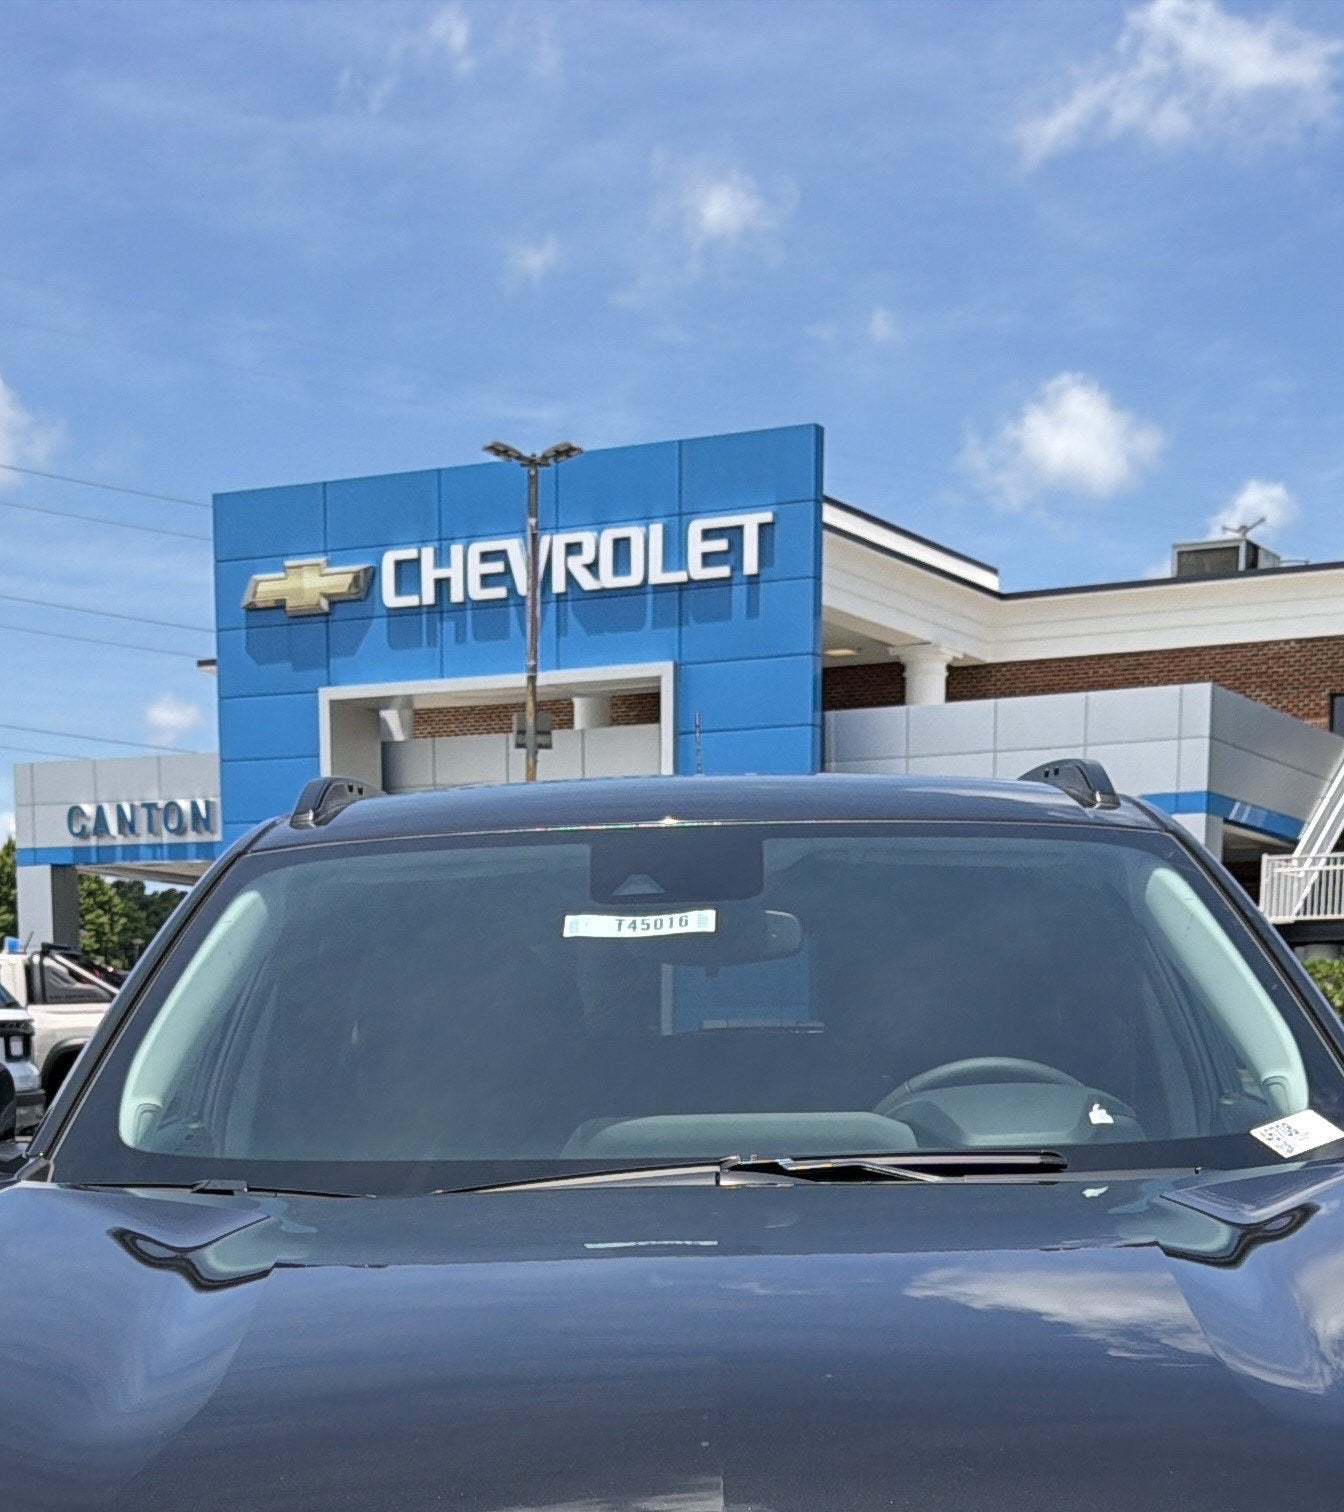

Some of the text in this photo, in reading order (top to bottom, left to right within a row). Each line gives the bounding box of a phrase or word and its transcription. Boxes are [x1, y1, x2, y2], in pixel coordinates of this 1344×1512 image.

[381, 511, 774, 609] CHEVROLET
[67, 800, 214, 839] CANTON
[615, 914, 689, 932] T45016
